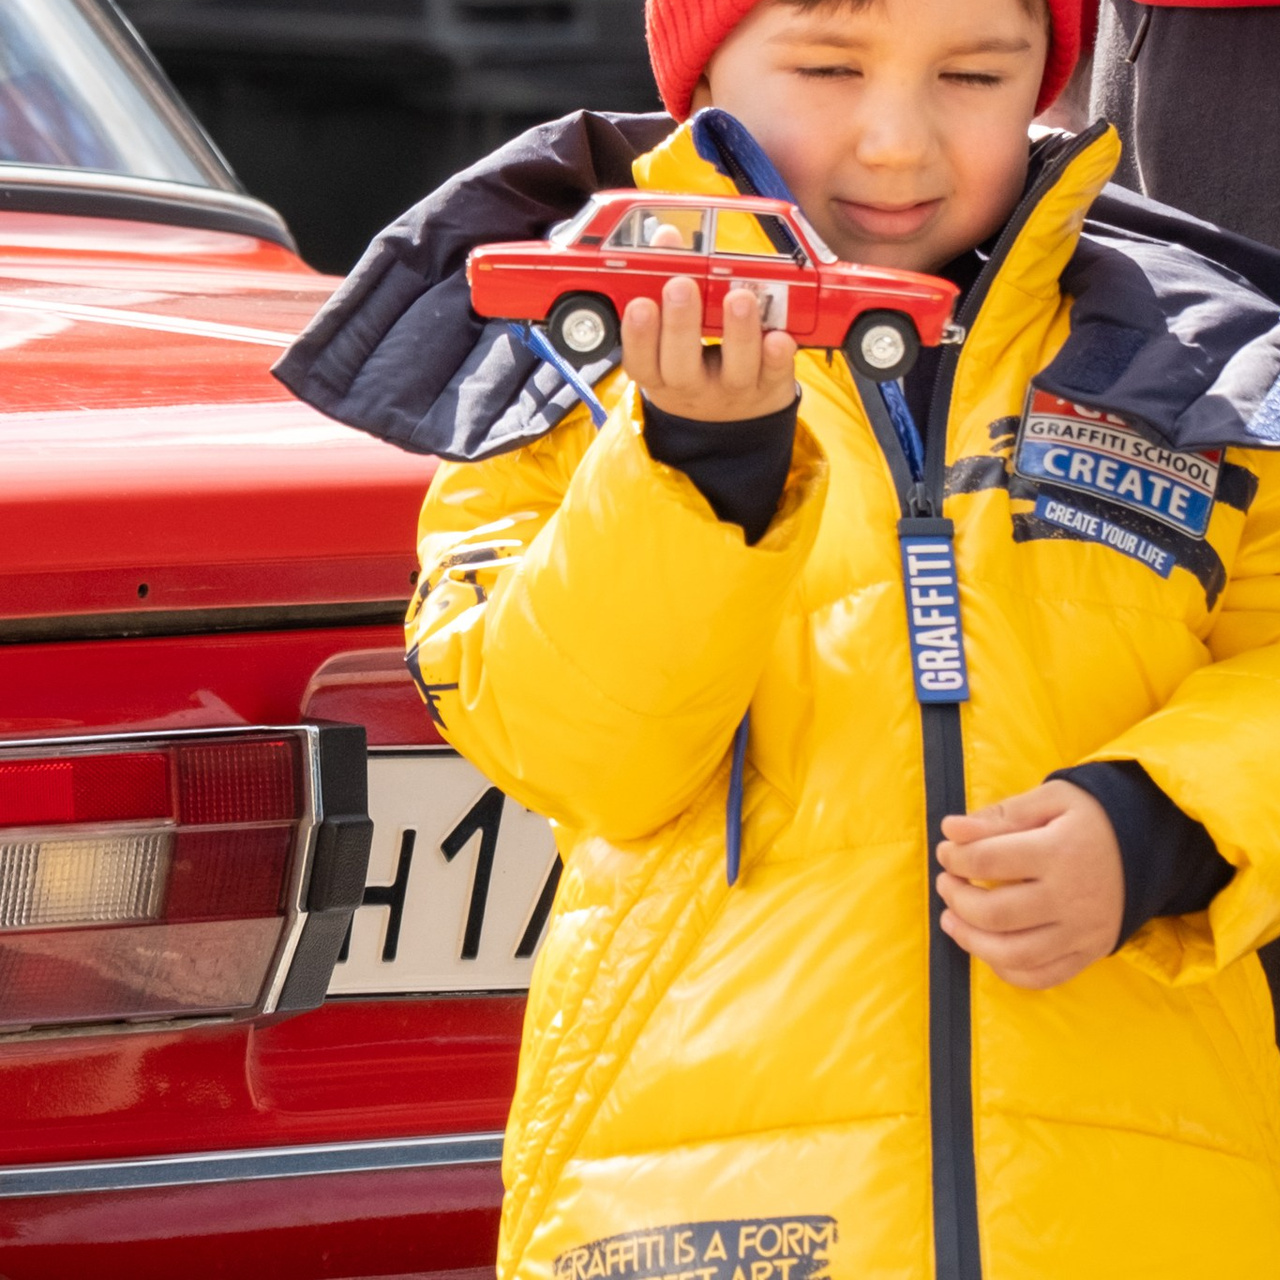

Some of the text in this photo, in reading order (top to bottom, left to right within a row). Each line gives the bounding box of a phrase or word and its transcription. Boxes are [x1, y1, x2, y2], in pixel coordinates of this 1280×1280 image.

[1030, 421, 1212, 488] GRAFFITI SCHOOL
[1043, 448, 1191, 521] CREATE
[1044, 501, 1168, 571] CREATE YOUR LIFE
[907, 544, 964, 691] GRAFFITI
[556, 1223, 835, 1280] GRAFFITI IS A FORM
